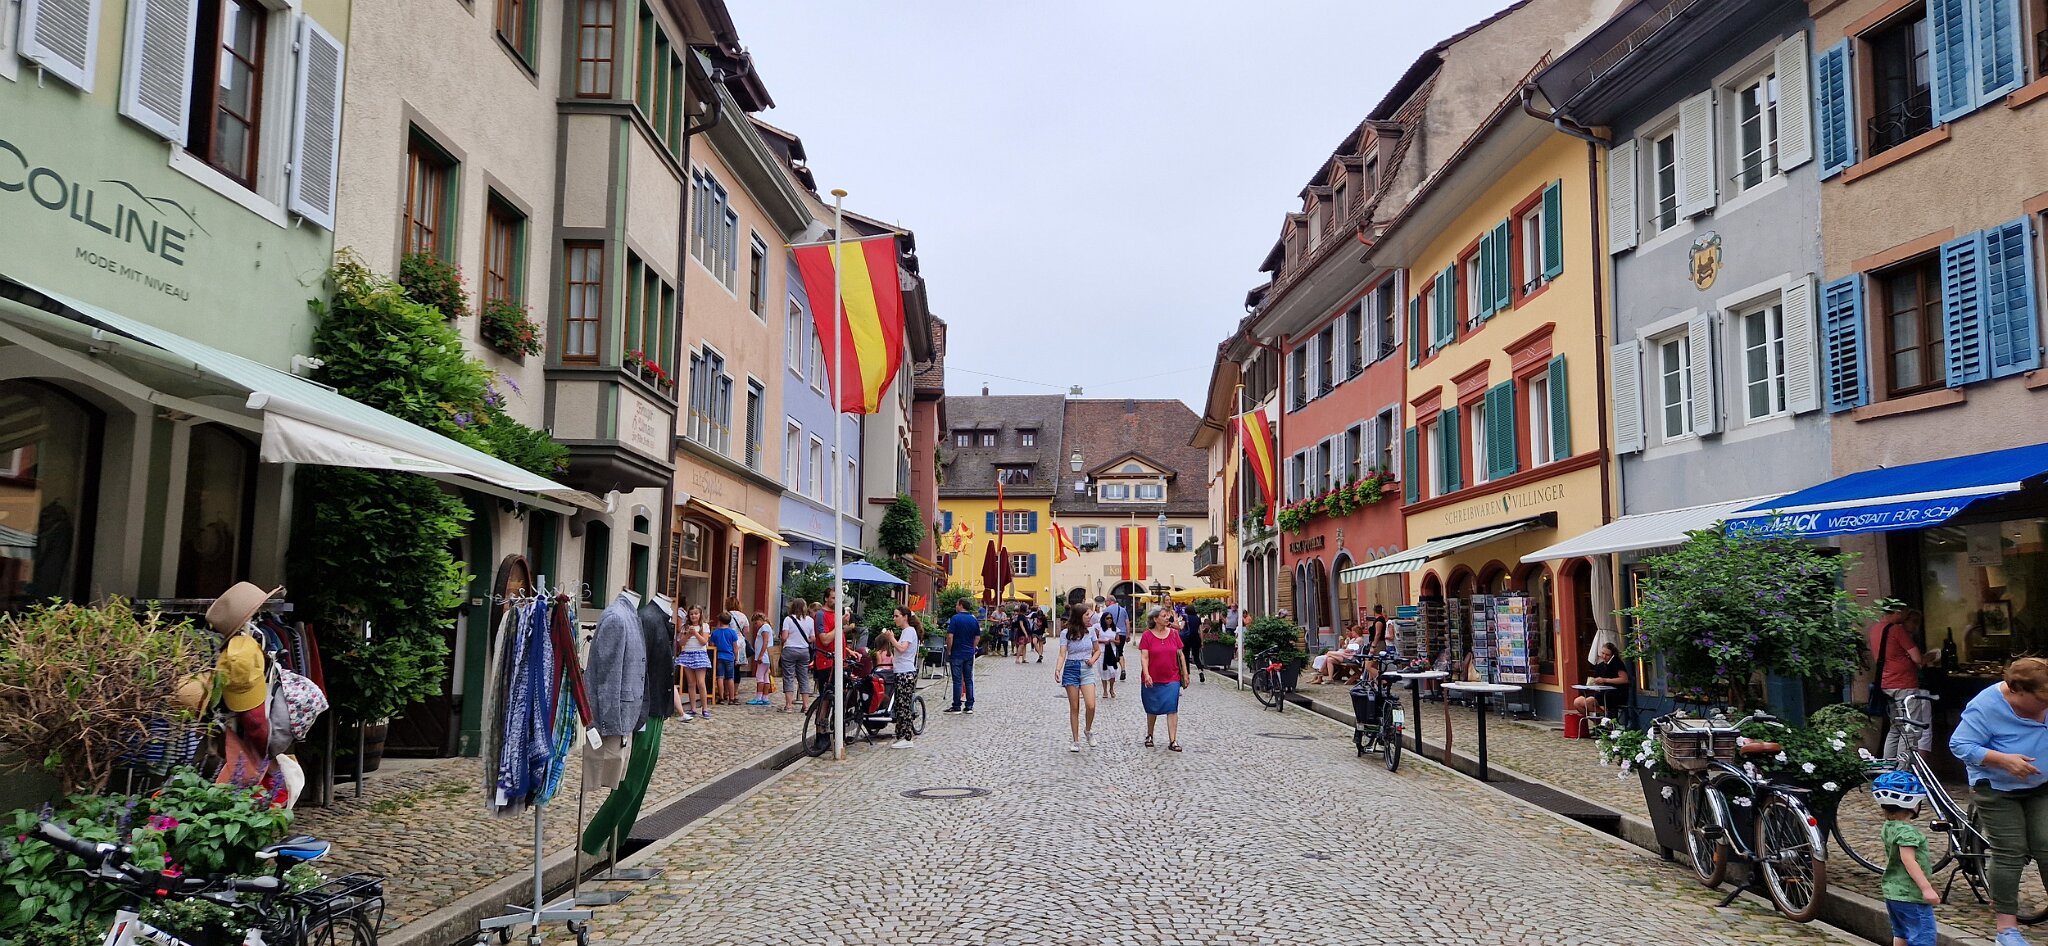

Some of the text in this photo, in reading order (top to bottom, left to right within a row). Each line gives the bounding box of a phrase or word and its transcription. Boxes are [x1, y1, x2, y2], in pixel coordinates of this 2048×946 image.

[0, 139, 187, 266] COLLINE
[75, 247, 191, 301] MODE MIT NIVEAU
[1444, 483, 1565, 525] SCHREIBWAREN VILLINGER
[1828, 512, 1891, 528] WERKSTATT
[1892, 508, 1920, 522] FÜR
